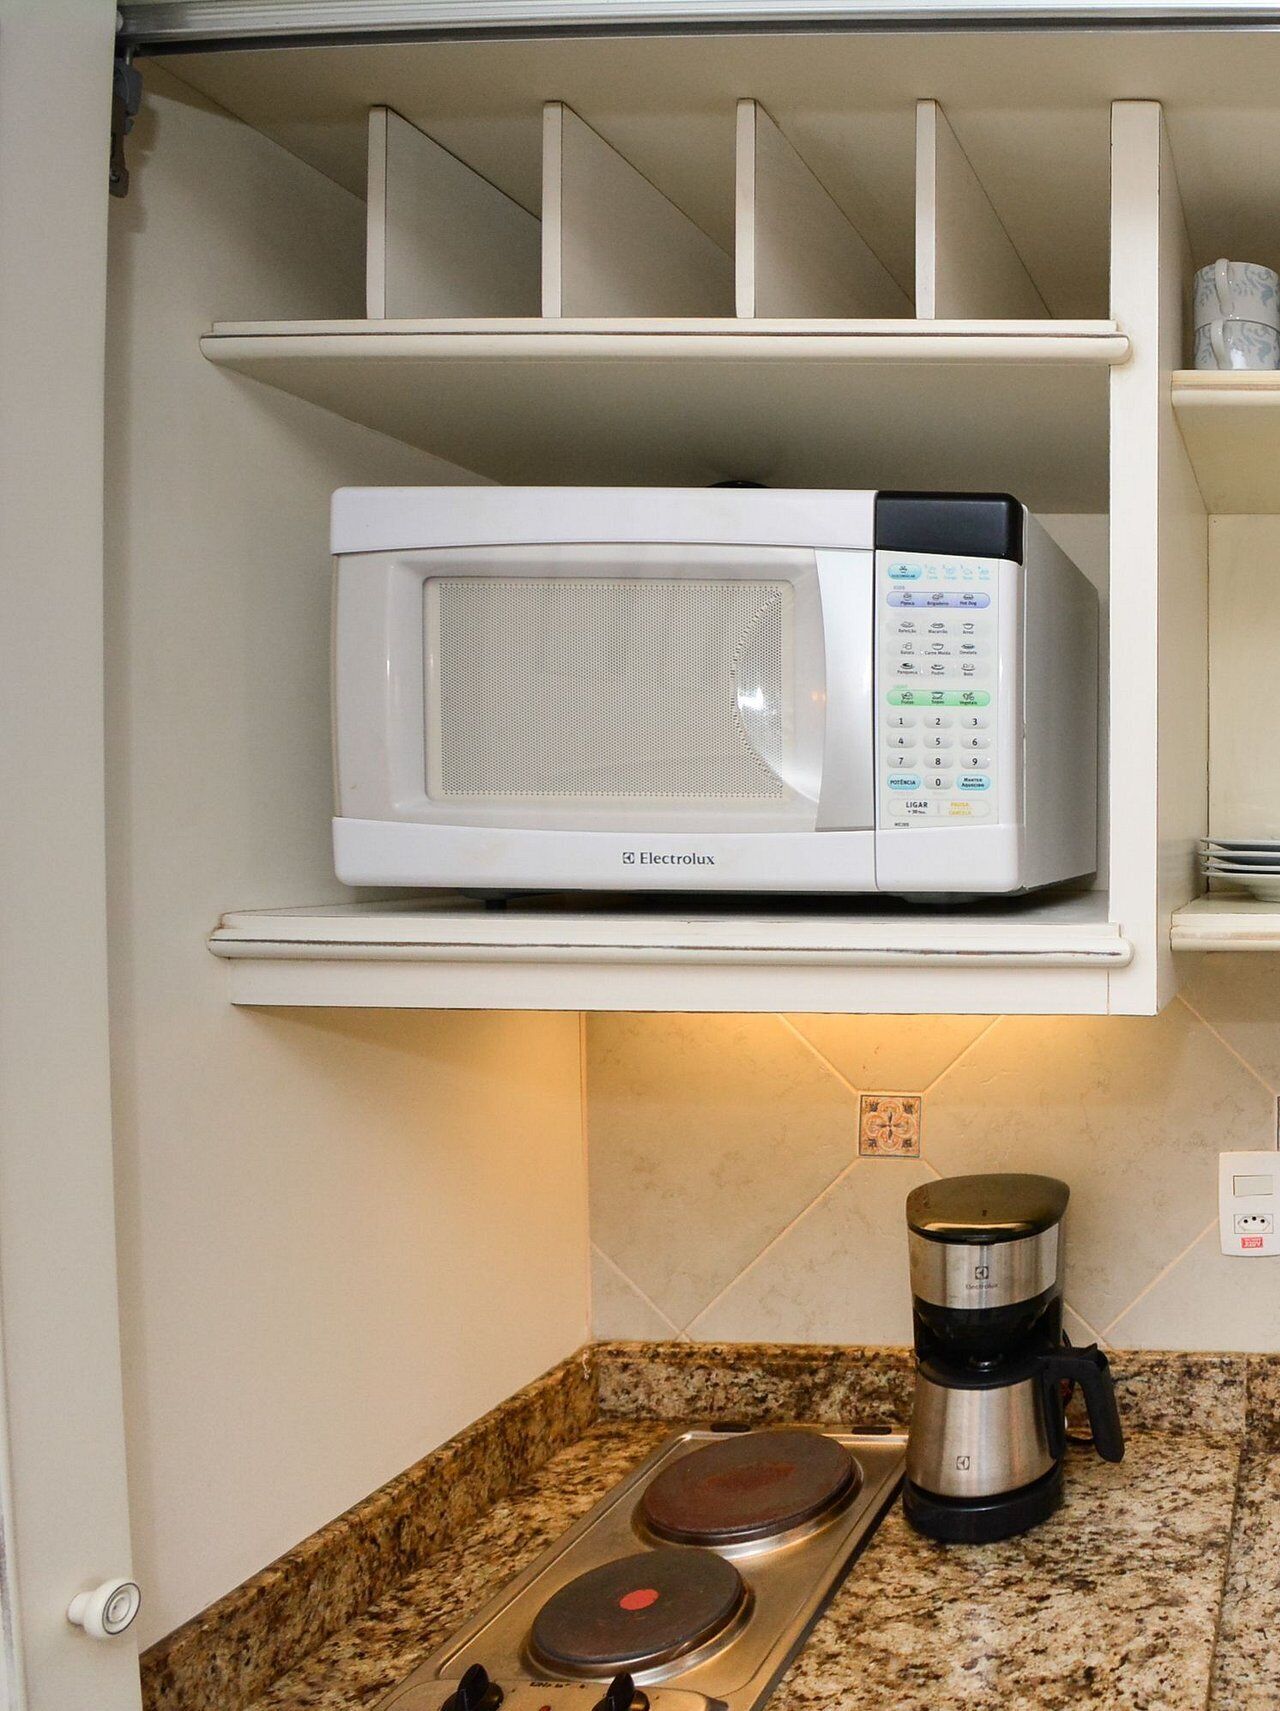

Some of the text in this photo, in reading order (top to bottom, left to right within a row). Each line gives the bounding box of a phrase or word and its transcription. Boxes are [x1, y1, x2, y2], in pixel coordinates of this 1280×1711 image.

[935, 718, 941, 726] 2
[972, 718, 978, 726] 3
[935, 738, 941, 746] 5
[972, 738, 978, 746] 6
[898, 757, 904, 765] 7
[935, 758, 941, 766] 8
[972, 758, 978, 766] 9
[935, 778, 941, 787] 0
[640, 852, 715, 865] Electrolux
